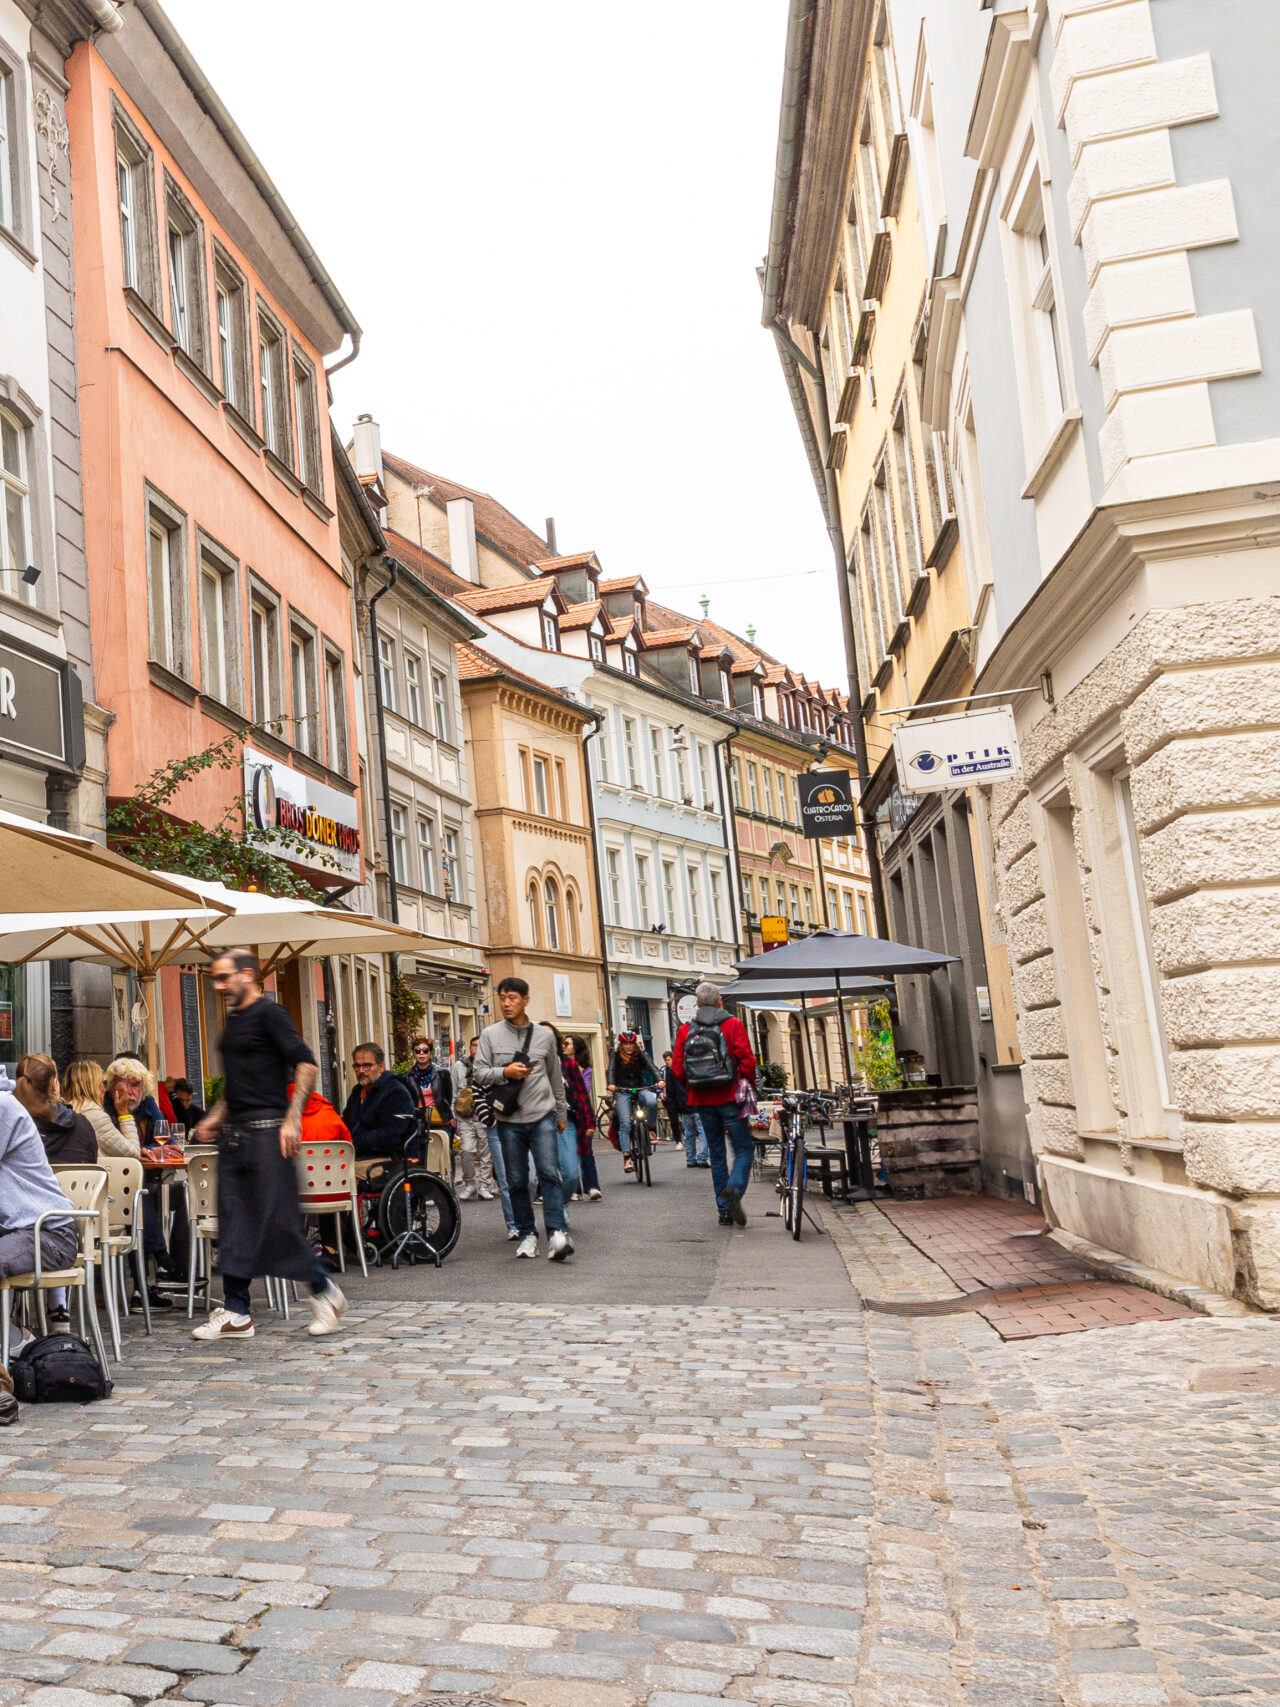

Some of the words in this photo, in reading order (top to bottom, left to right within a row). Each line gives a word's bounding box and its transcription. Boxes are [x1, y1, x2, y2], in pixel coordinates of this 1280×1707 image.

[279, 798, 305, 835] BROS
[305, 805, 338, 848] DÖNER
[338, 822, 360, 853] HAUS
